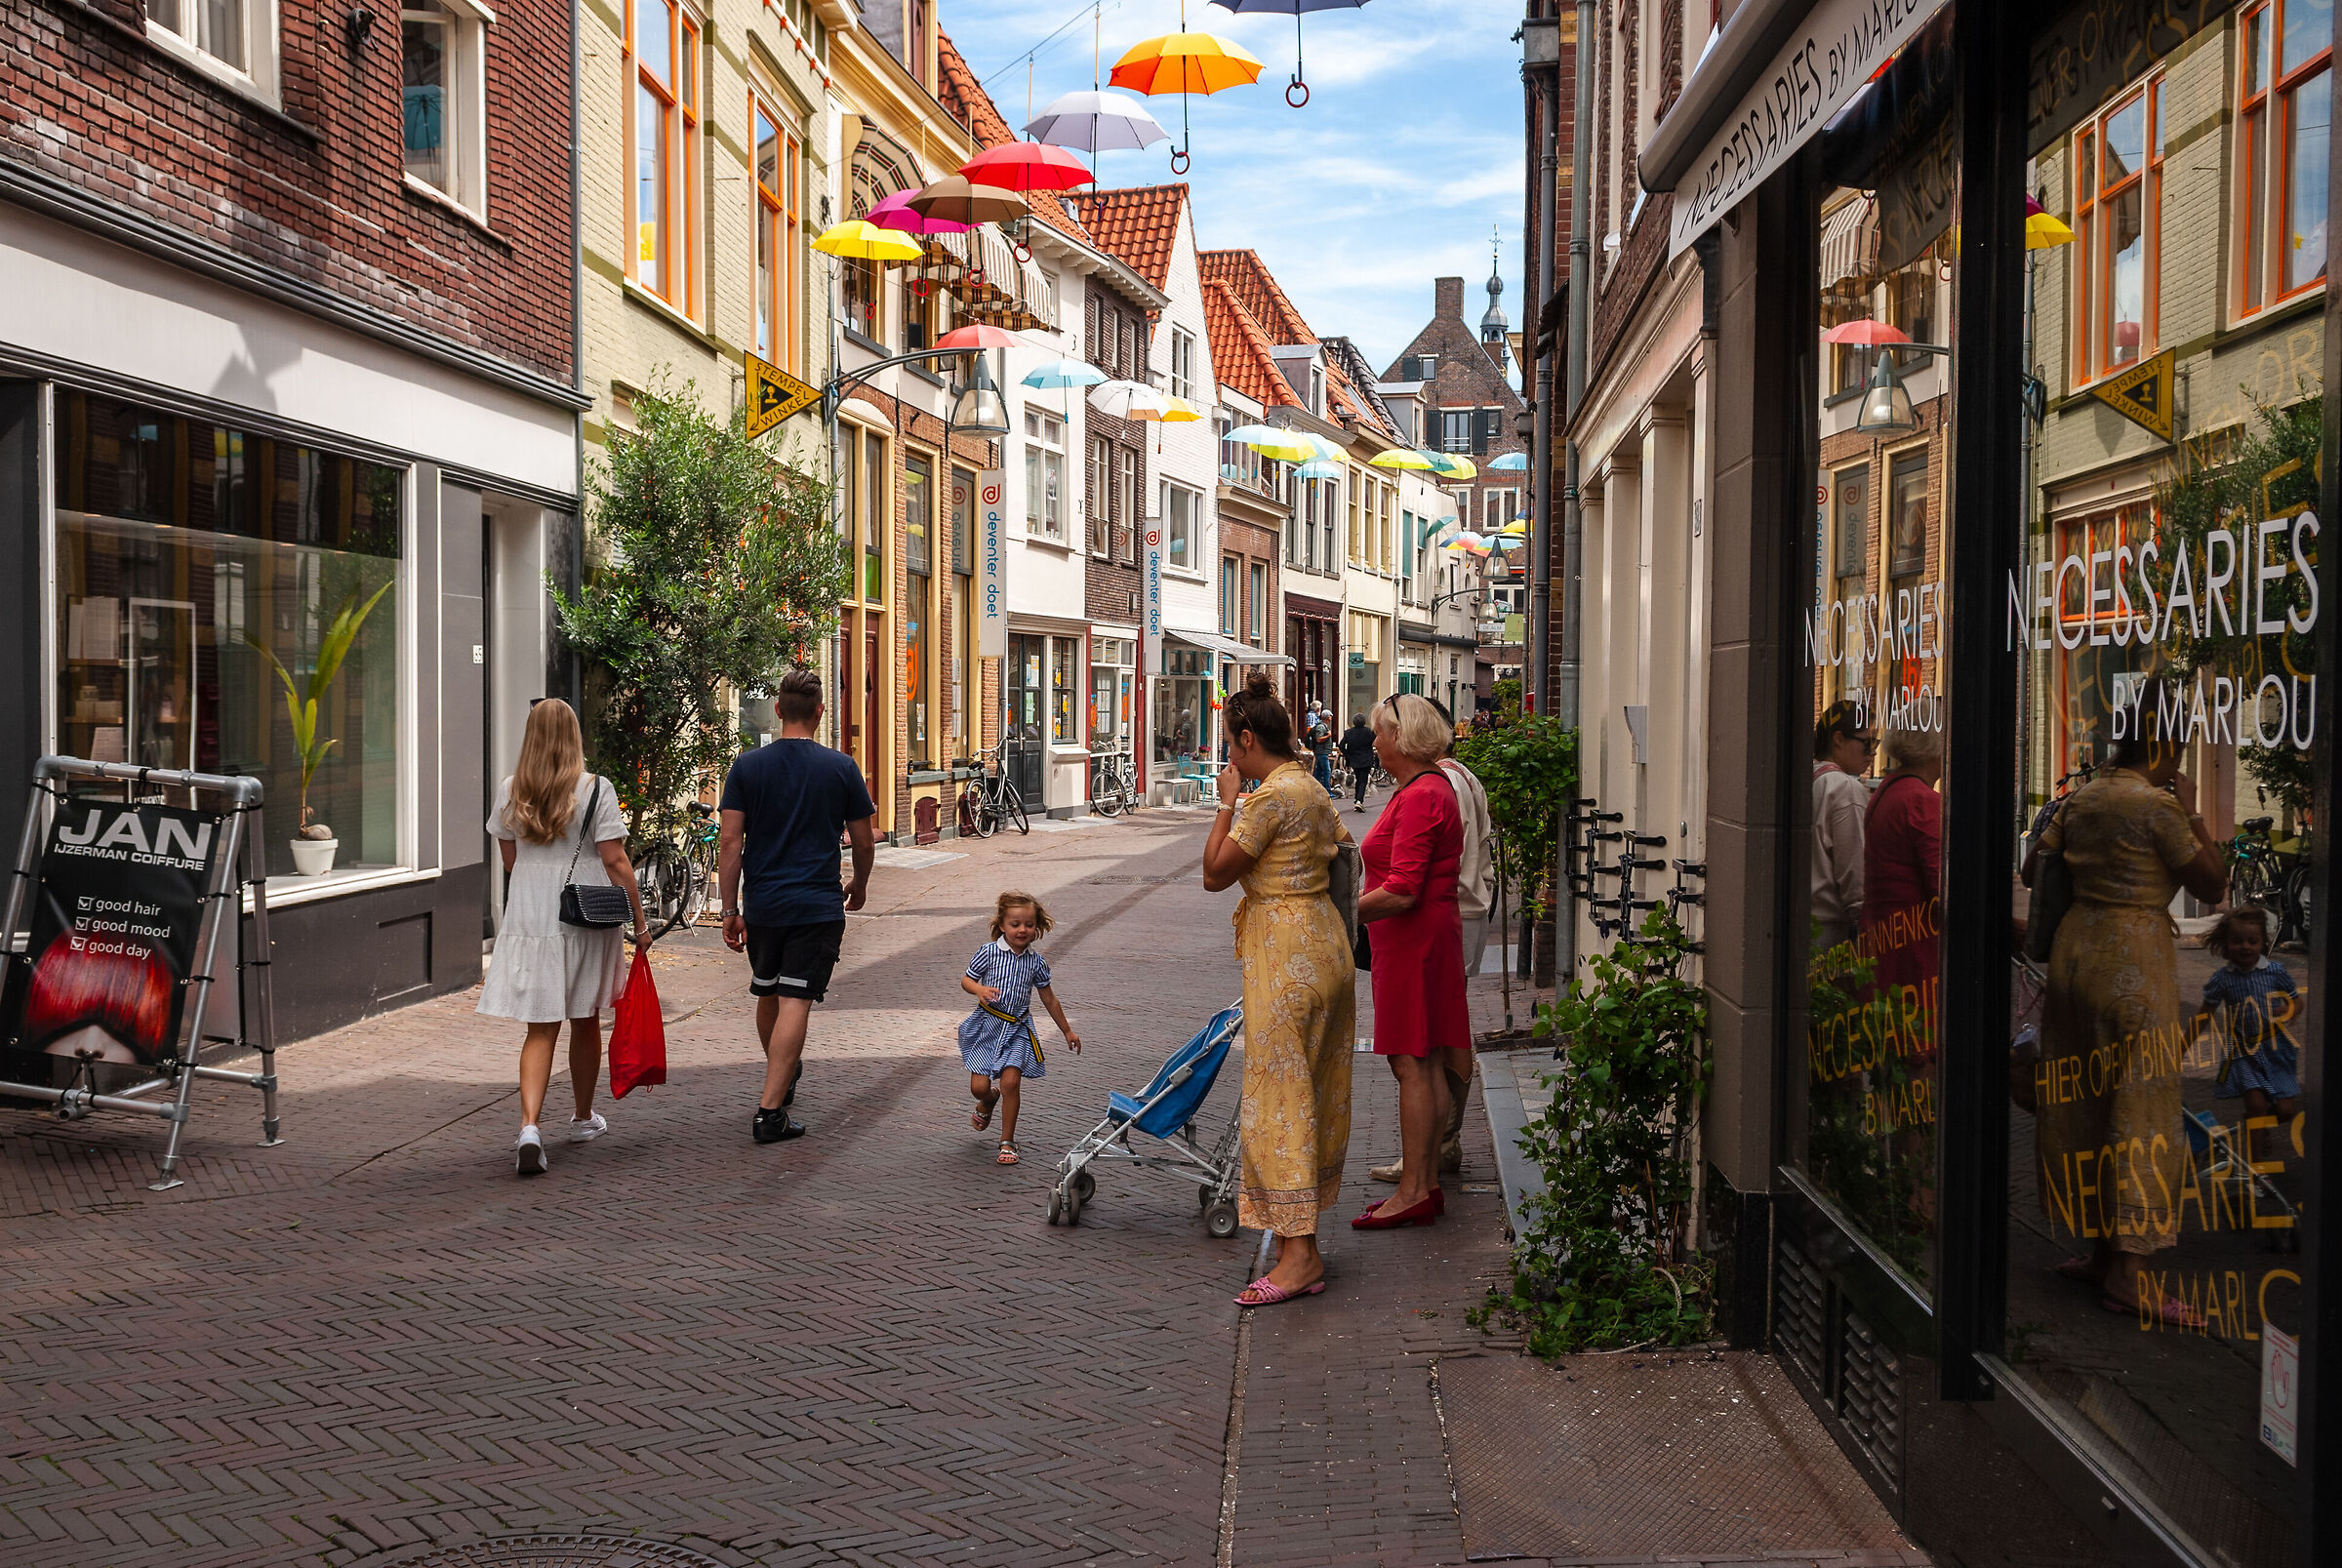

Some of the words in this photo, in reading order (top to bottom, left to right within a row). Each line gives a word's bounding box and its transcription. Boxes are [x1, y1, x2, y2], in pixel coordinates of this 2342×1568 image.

[1679, 37, 1822, 238] NECESSARIES
[1828, 29, 1847, 101] BY
[1851, 0, 1918, 76] MARL
[754, 362, 809, 400] STEMPEL
[987, 511, 1001, 578] deventer
[987, 583, 1000, 619] doet
[1150, 551, 1161, 604] deventer
[2006, 510, 2321, 652] NECESSARIES
[1150, 609, 1161, 636] doet
[1804, 581, 1946, 667] NECESSARIES
[1855, 686, 1873, 730] BY
[1876, 683, 1943, 734] MARLOU
[2112, 677, 2147, 742] BY
[2156, 673, 2318, 750] MARLOU
[54, 843, 128, 861] IJZERMAN
[131, 852, 205, 871] COIFFURE
[59, 809, 213, 861] JAN
[92, 919, 128, 933] good
[130, 925, 171, 938] mood
[96, 900, 132, 912] good
[134, 902, 161, 916] hair
[89, 942, 124, 954] good
[126, 945, 151, 960] day
[2035, 1055, 2084, 1106] HIER
[2088, 1033, 2134, 1098] OPENT
[2137, 1268, 2166, 1331] BY
